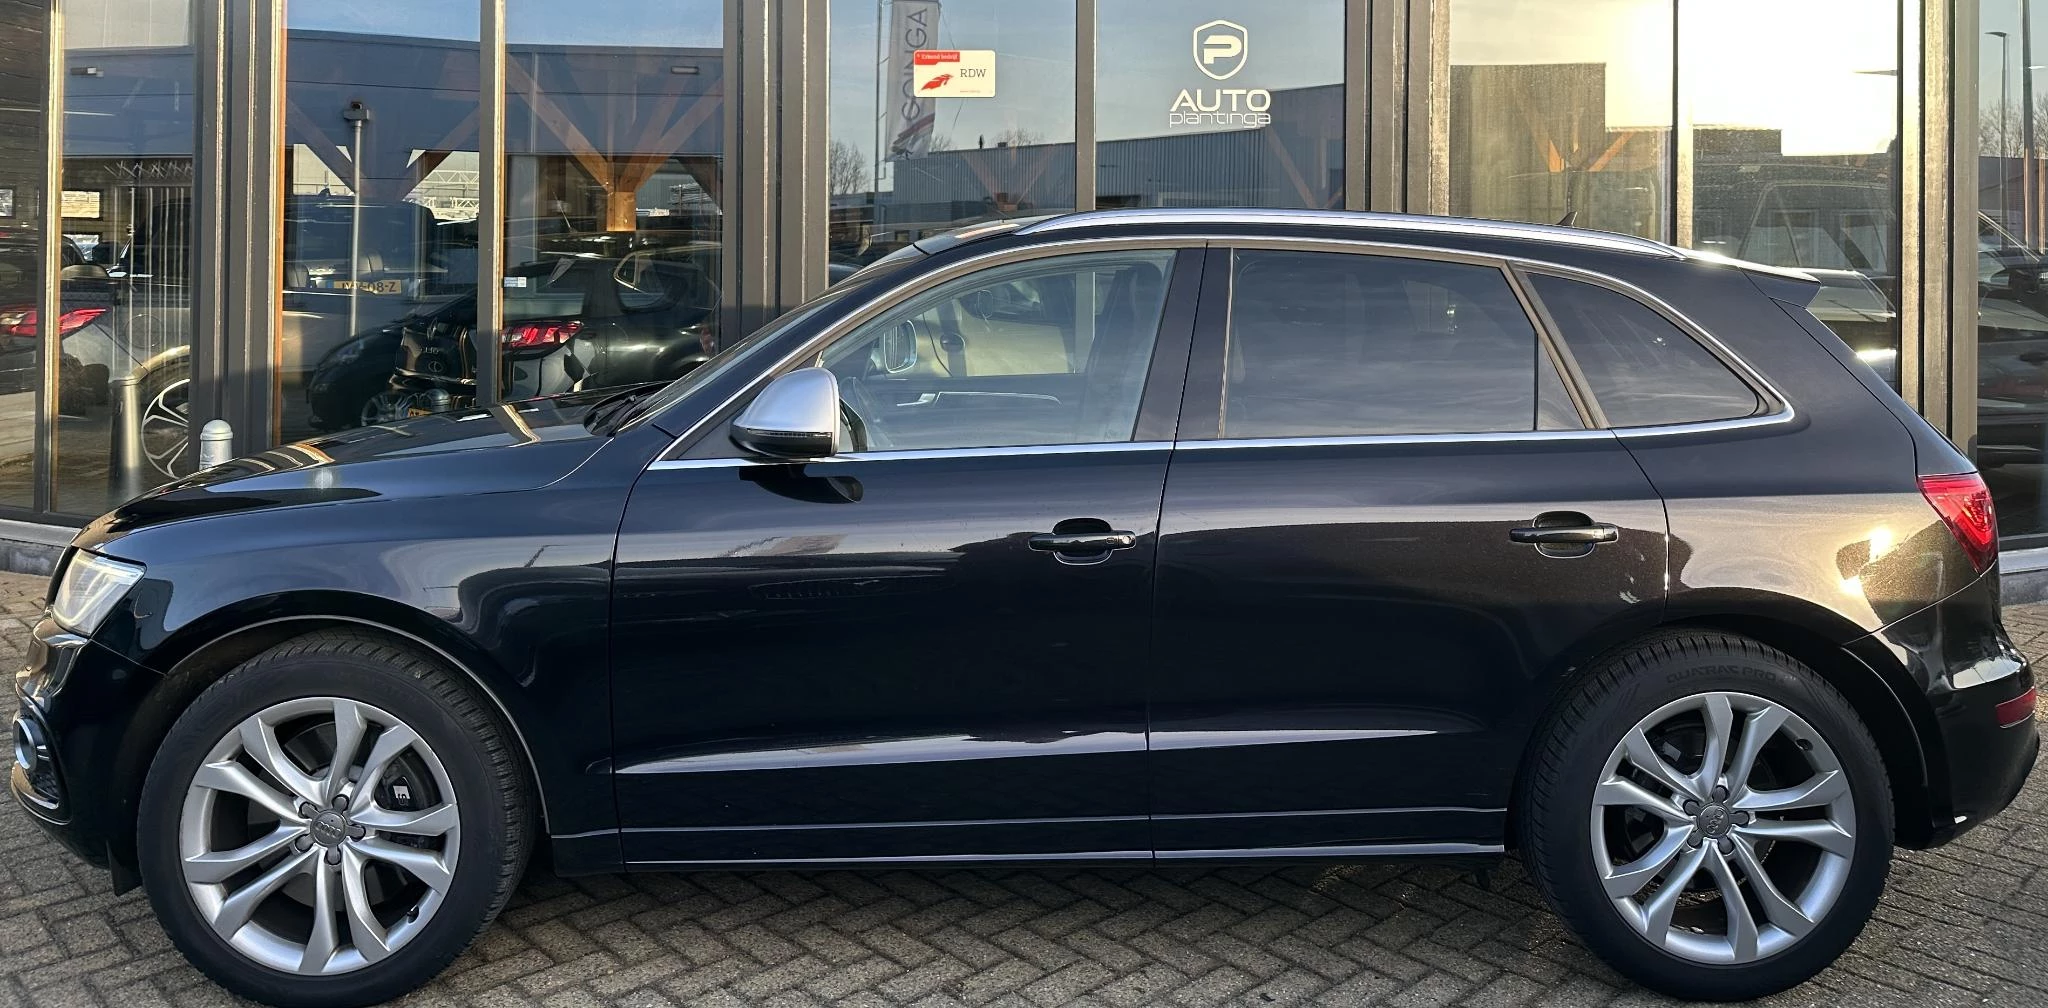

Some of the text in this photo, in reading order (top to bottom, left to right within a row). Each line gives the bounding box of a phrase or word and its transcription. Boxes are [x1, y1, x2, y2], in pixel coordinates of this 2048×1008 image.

[1203, 35, 1242, 64] P
[960, 68, 987, 78] RDW
[1170, 89, 1271, 112] AUTO
[1169, 111, 1271, 129] plantinga
